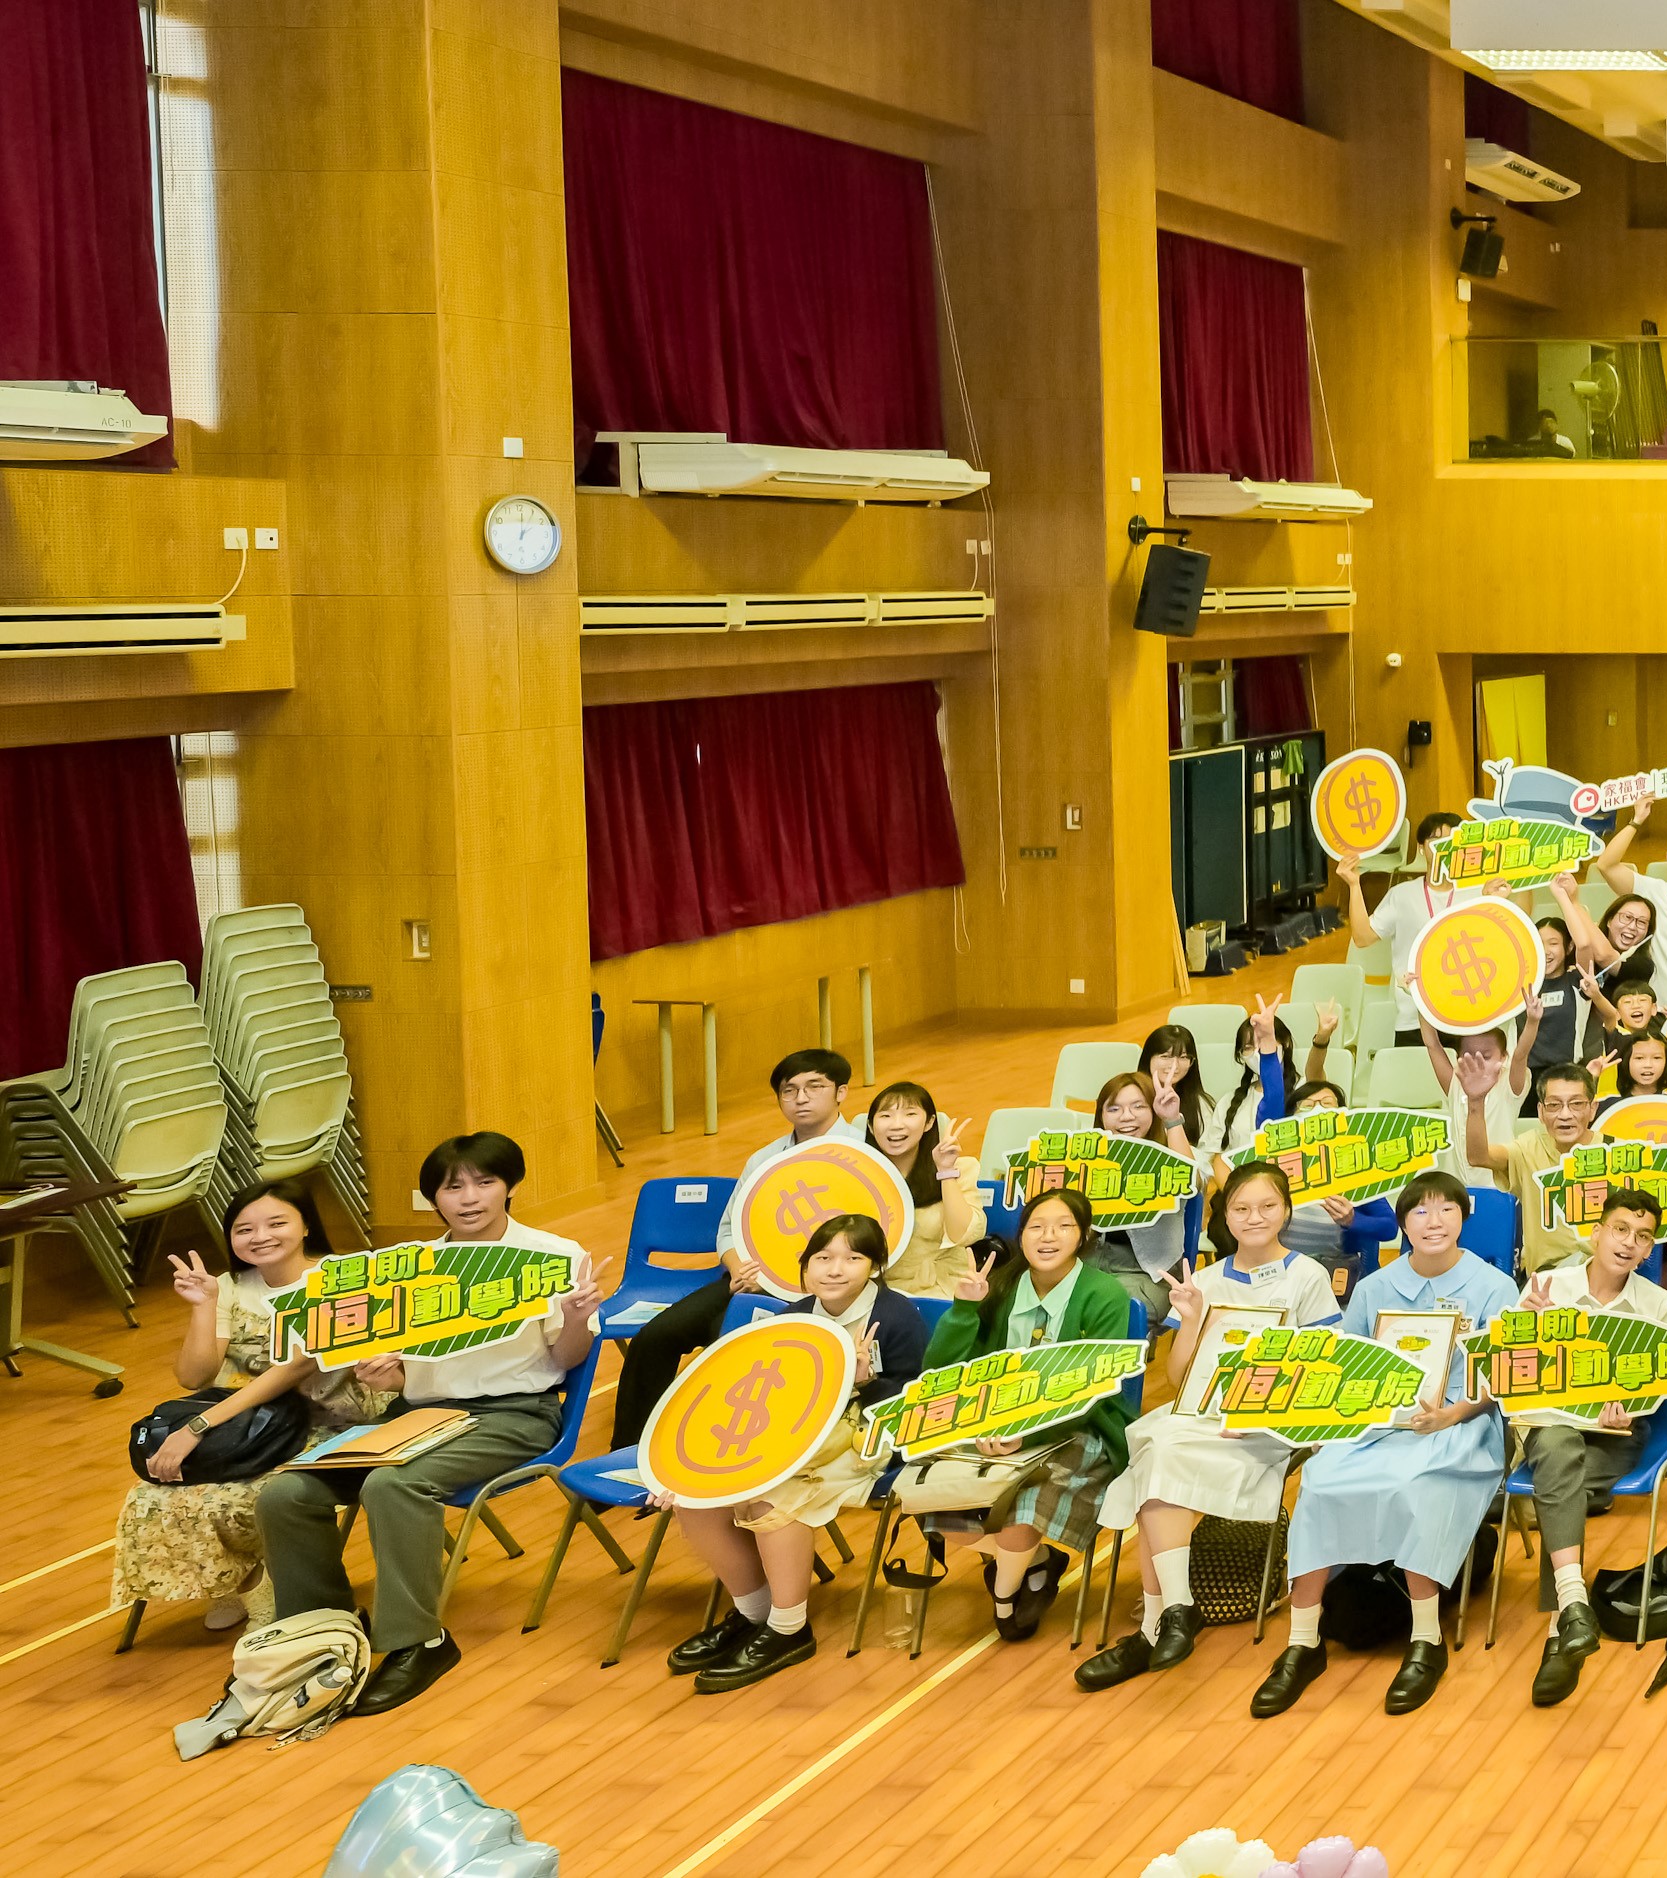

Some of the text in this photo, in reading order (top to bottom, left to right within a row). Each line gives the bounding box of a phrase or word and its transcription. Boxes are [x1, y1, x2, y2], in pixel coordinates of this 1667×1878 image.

[101, 417, 132, 428] AC-10
[1604, 776, 1648, 798] 家福會
[1459, 818, 1514, 845] 理財
[1038, 1131, 1103, 1161] 理財
[1264, 1107, 1347, 1152] 理財
[1571, 1144, 1653, 1178] 理財
[320, 1243, 423, 1296] 理財
[1499, 1308, 1580, 1344] 理財
[1254, 1327, 1334, 1364] 理財
[919, 1351, 1015, 1400] 理財
